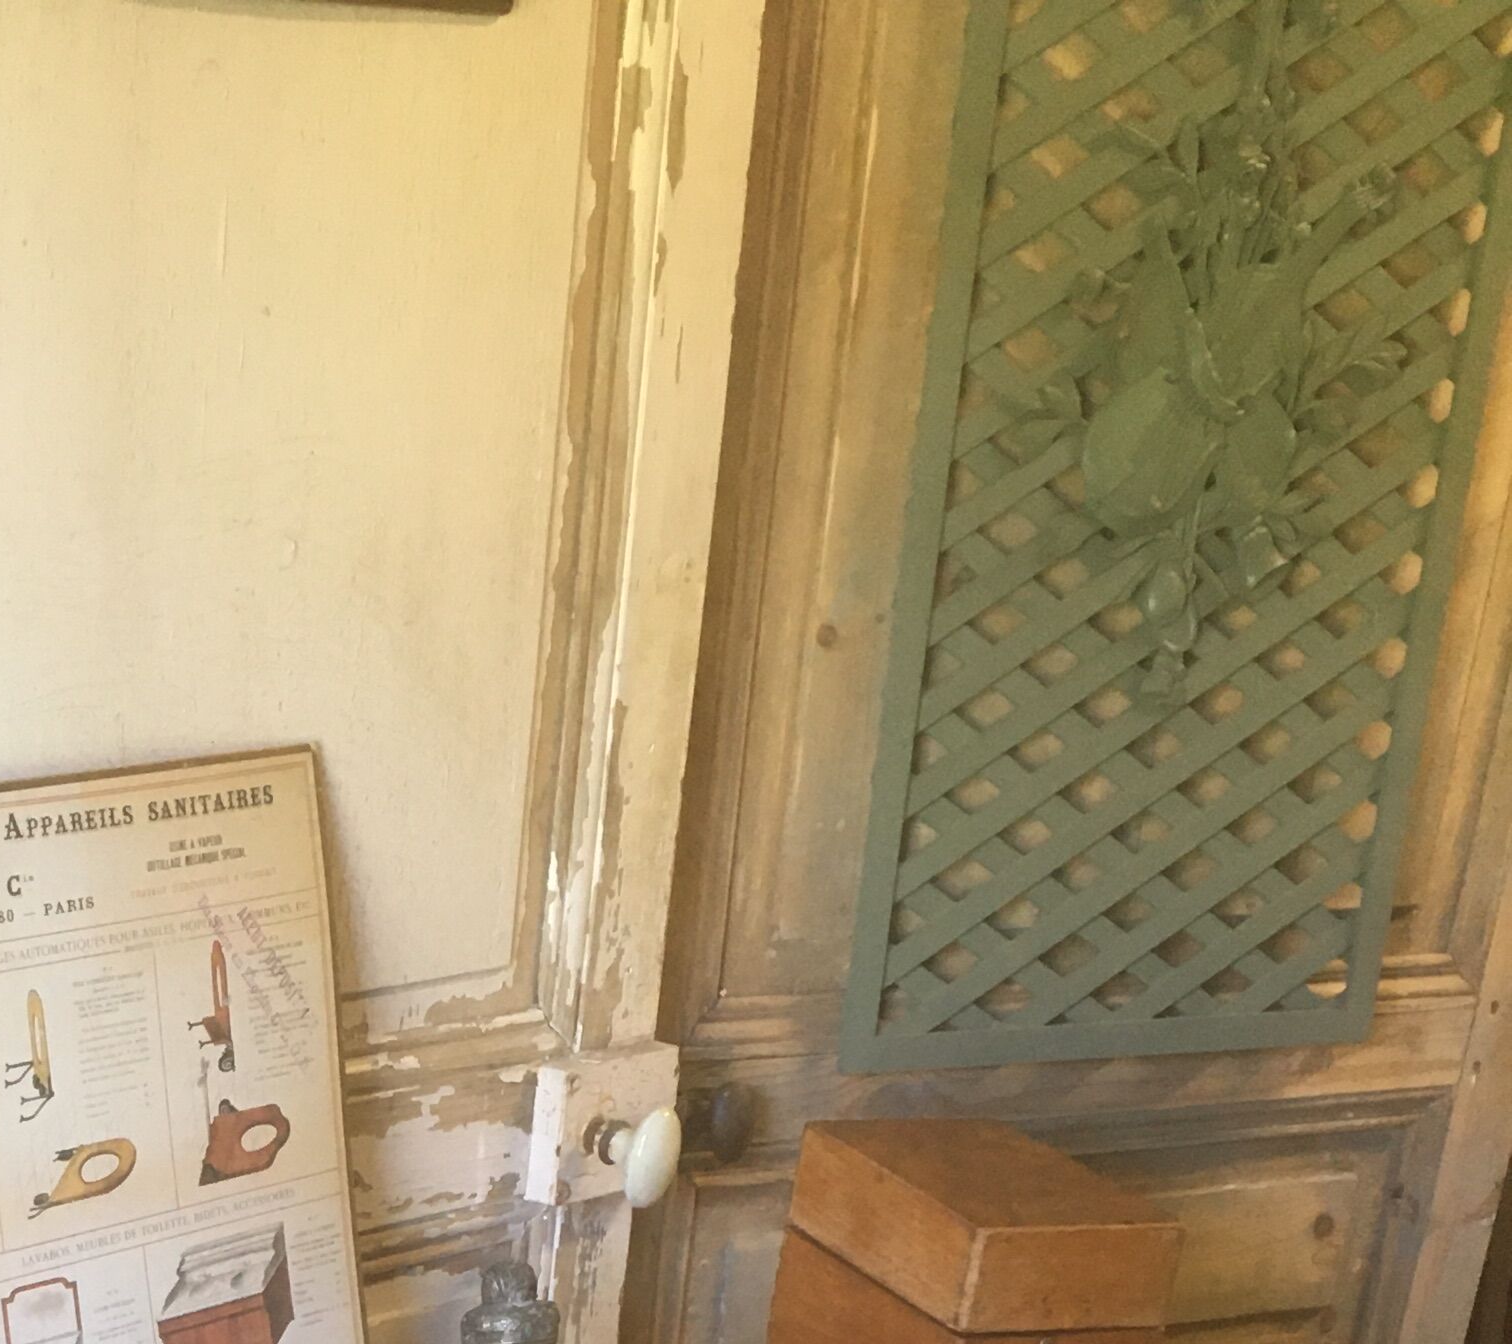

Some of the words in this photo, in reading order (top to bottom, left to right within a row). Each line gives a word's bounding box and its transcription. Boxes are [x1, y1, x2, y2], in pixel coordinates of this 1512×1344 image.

[4, 804, 135, 842] APPAREILS
[148, 785, 274, 822] SANITAIRES
[43, 896, 96, 917] PARIS
